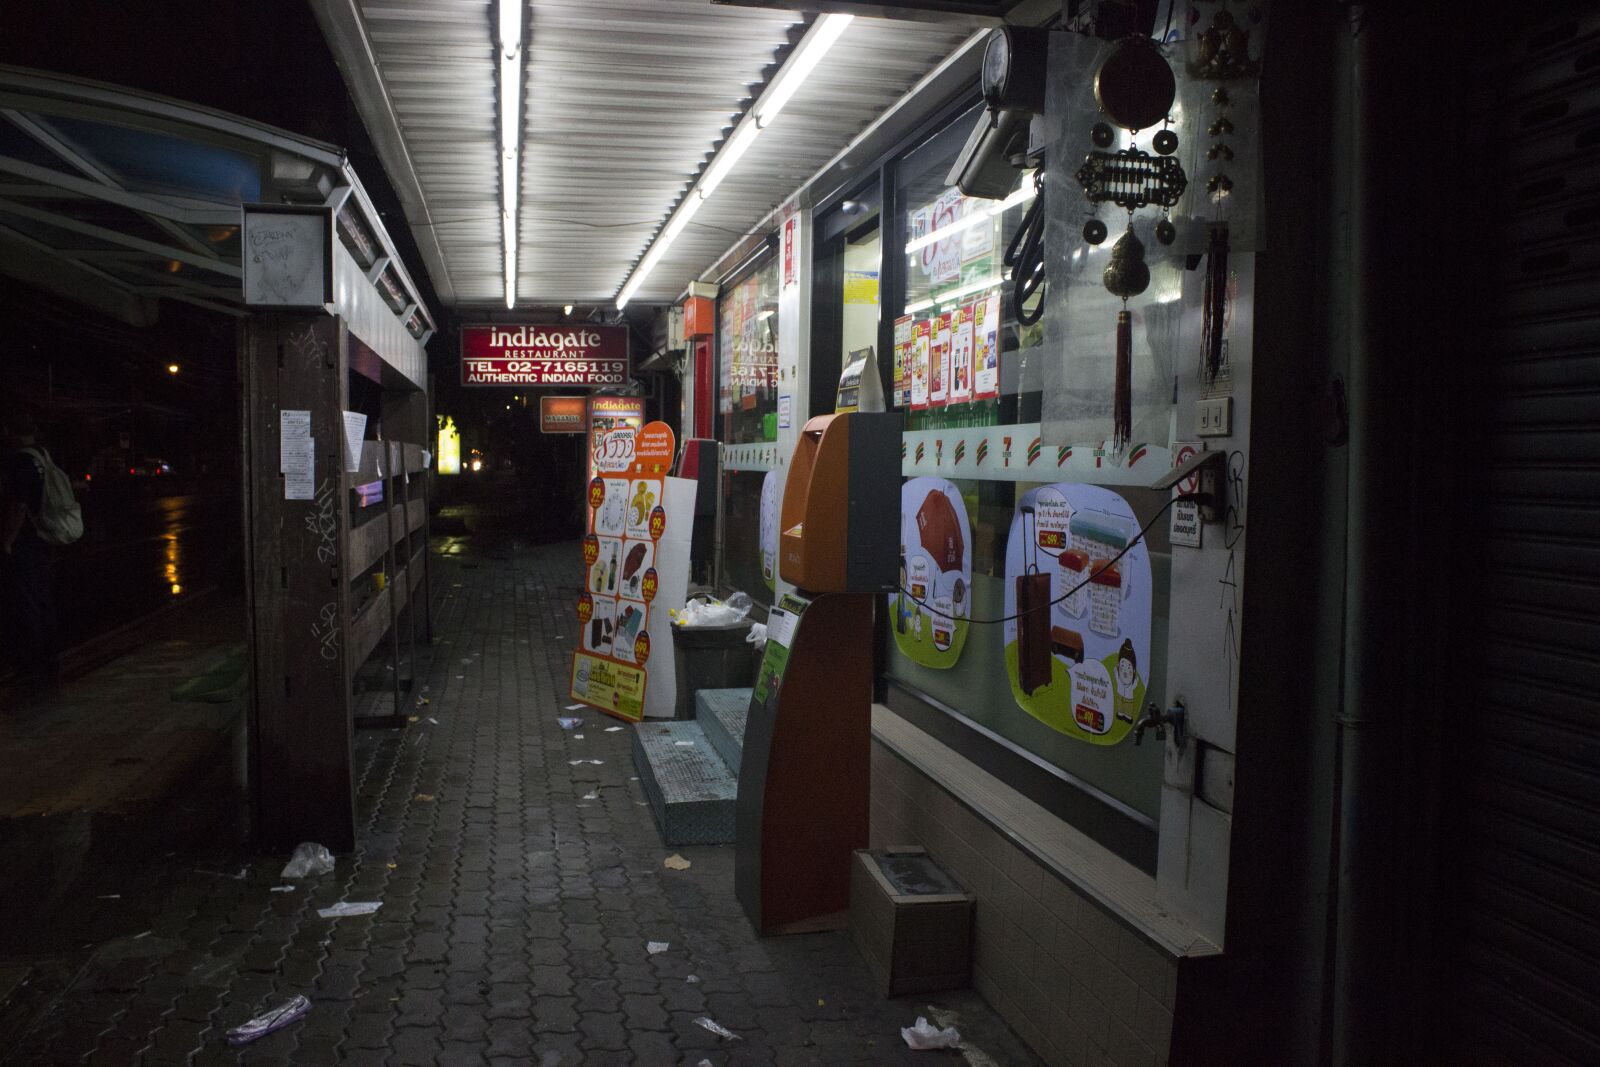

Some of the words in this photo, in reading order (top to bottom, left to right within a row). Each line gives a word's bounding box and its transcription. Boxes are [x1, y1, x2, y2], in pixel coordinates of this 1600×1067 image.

[489, 326, 601, 351] indiagate
[505, 350, 586, 359] RESTAURANT
[467, 361, 501, 372] TEL.
[507, 361, 624, 373] 02-7165119
[467, 373, 538, 383] AUTHENTIC
[541, 373, 584, 383] INDIAN
[587, 373, 623, 383] FOOD
[592, 400, 641, 411] indiagate
